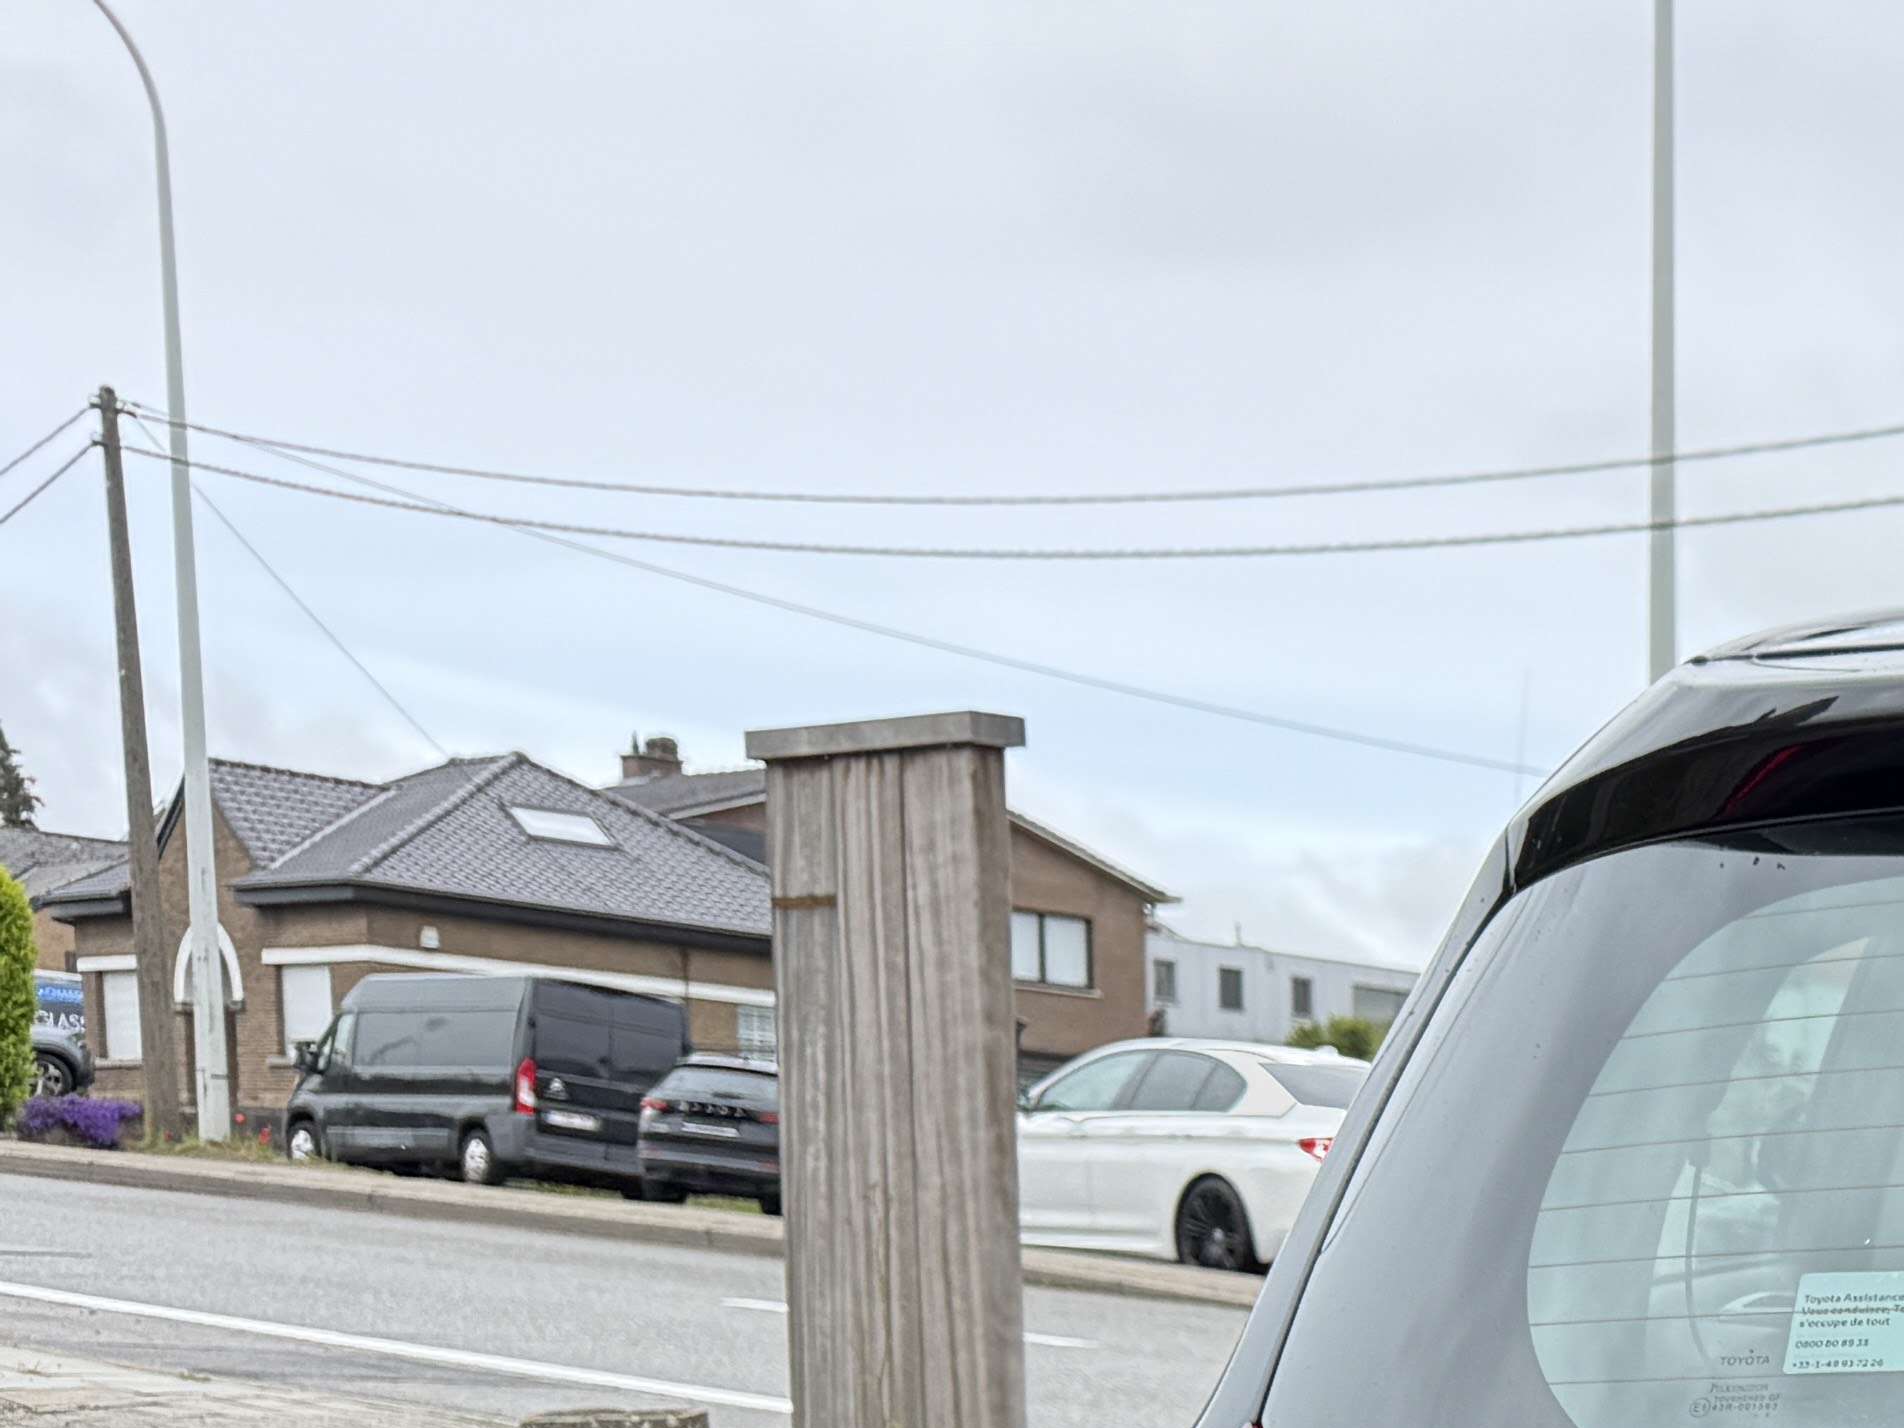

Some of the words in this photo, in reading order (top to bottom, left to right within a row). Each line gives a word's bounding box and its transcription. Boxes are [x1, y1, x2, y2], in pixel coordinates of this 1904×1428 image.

[1804, 1294, 1841, 1306] Toyota
[1850, 1317, 1864, 1327] de
[1866, 1316, 1891, 1327] tout
[1719, 1355, 1770, 1367] TOYOTA
